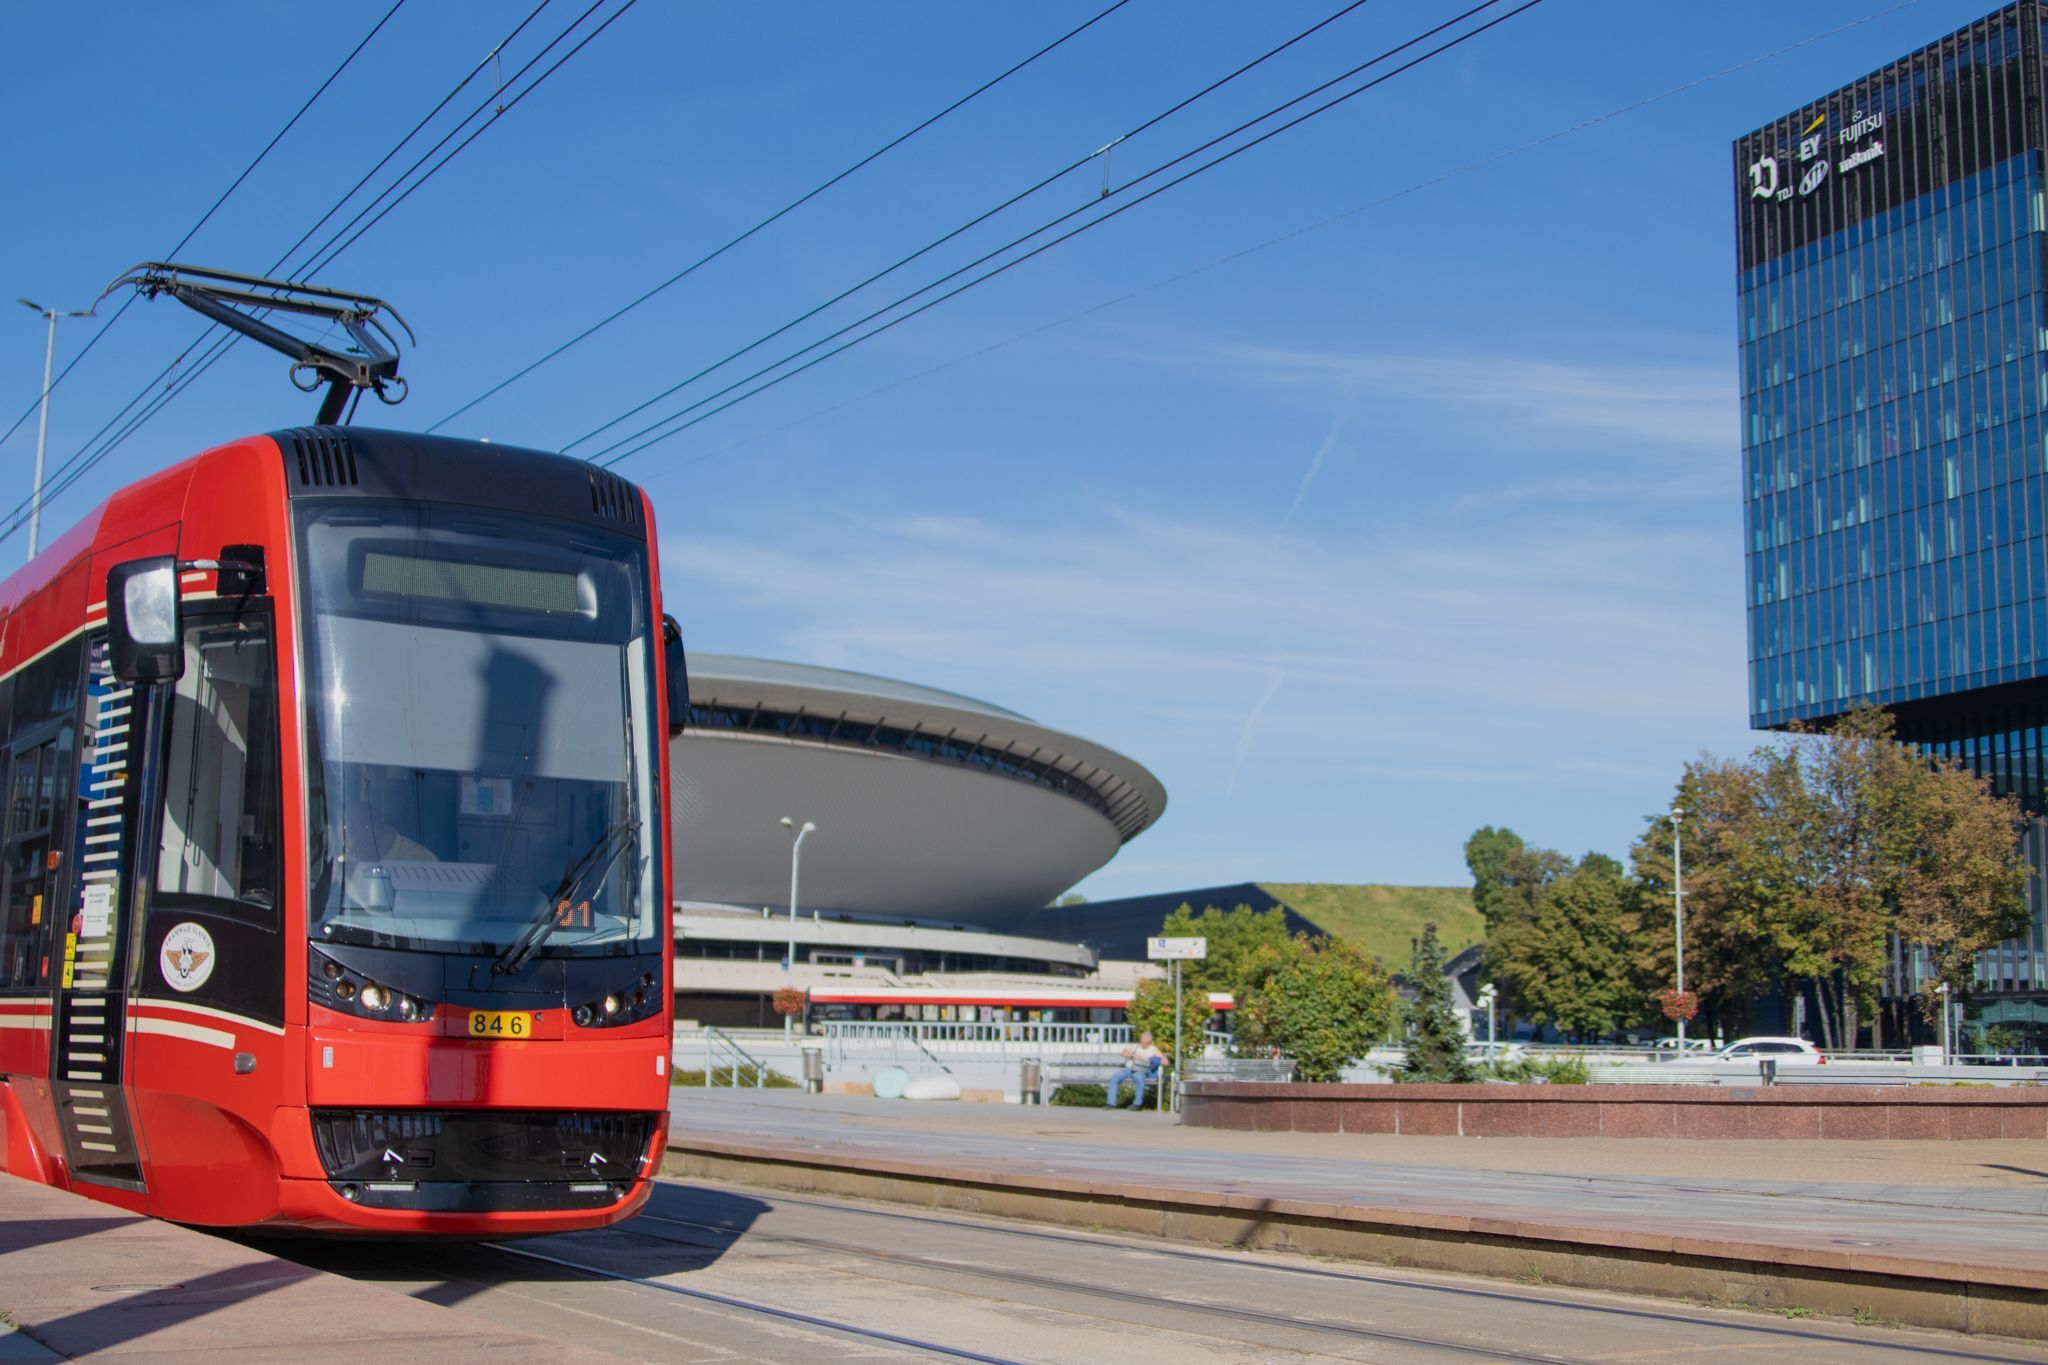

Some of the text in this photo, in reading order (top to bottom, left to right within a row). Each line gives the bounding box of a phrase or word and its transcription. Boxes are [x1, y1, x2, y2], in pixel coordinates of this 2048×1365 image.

[1839, 111, 1882, 145] FUJITSU
[1800, 133, 1821, 162] EY
[1838, 141, 1884, 173] mBank
[1776, 184, 1793, 202] TDJ
[474, 1014, 522, 1035] 846
